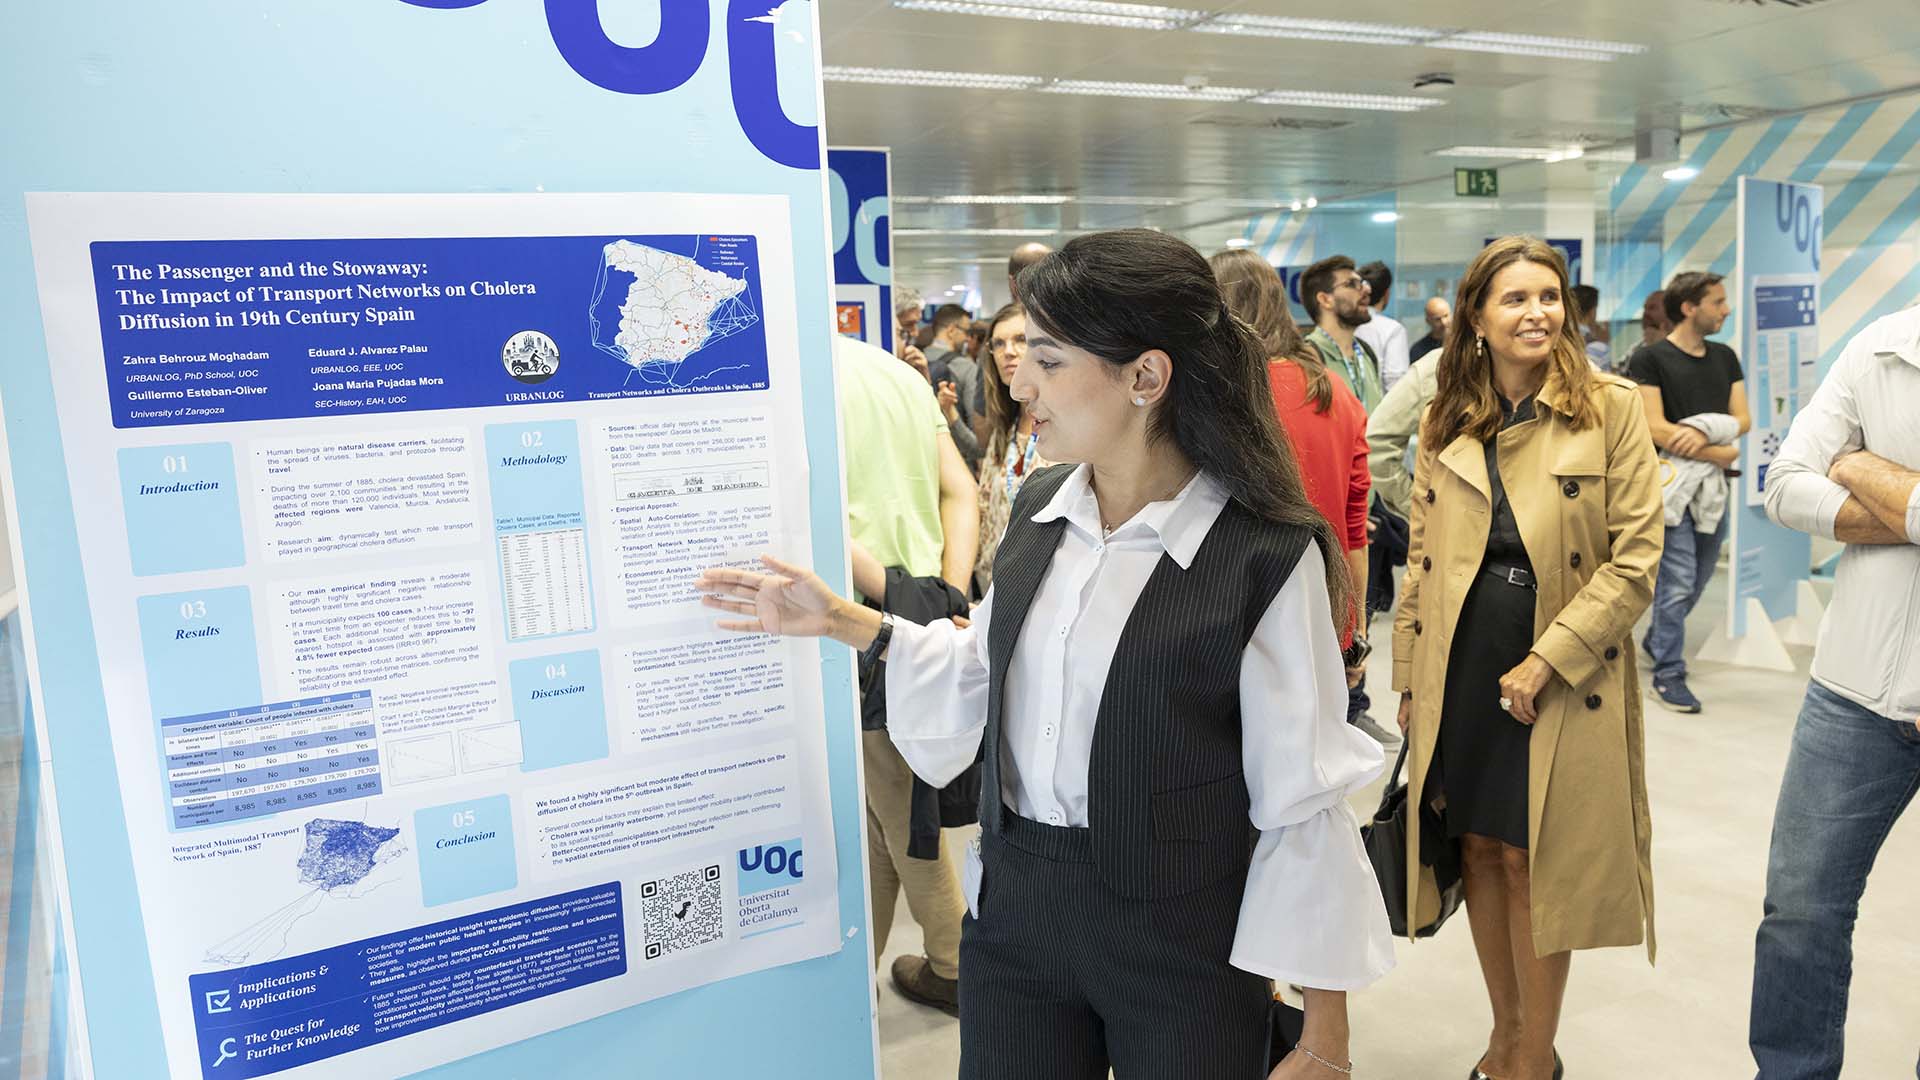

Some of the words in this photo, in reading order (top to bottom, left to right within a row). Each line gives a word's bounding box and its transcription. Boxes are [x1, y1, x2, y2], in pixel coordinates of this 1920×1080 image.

[112, 265, 152, 280] The
[158, 264, 254, 282] Passenger
[260, 262, 294, 277] and
[299, 262, 328, 276] the
[333, 261, 427, 278] Stowaway:
[116, 290, 155, 305] The
[160, 289, 230, 307] Impact
[236, 287, 255, 302] of
[259, 286, 353, 304] Transport
[357, 283, 440, 298] Networks
[445, 286, 466, 296] on
[471, 281, 536, 296] Cholera
[119, 313, 210, 330] Diffusion
[216, 312, 234, 327] in
[240, 311, 280, 326] 19th
[286, 310, 360, 326] Century
[366, 307, 415, 325] Spain
[123, 356, 156, 365] Zahra
[160, 354, 207, 363] Behrouz
[209, 352, 269, 362] Moghadam
[309, 348, 346, 357] Eduard
[400, 345, 427, 353] Palau
[126, 373, 182, 383] URBANLOG,
[311, 365, 361, 374] URBANLOG,
[128, 391, 183, 400] Guillermo
[187, 386, 267, 397] Esteban-Oliver
[313, 383, 344, 391] Joana
[347, 380, 374, 389] Maria
[377, 378, 416, 389] Pujadas
[506, 391, 564, 402] URBANLOG
[131, 410, 173, 418] University
[521, 431, 543, 448] 02
[163, 456, 188, 473] 01
[503, 454, 567, 466] Methodology
[141, 481, 218, 495] Introduction
[181, 600, 206, 620] 03
[176, 626, 219, 639] Results
[545, 664, 567, 679] 04
[532, 685, 584, 699] Discussion
[183, 724, 216, 733] Dependent
[550, 796, 570, 805] found
[600, 784, 635, 795] significant
[649, 776, 679, 786] moderate
[708, 764, 736, 774] transport
[738, 759, 766, 768] networks
[235, 802, 256, 812] 8,985
[266, 797, 287, 806] 8,985
[297, 791, 318, 801] 8,985
[327, 786, 347, 796] 8,985
[357, 781, 377, 790] 8,985
[538, 806, 568, 816] diffusion
[578, 800, 603, 808] cholera
[635, 787, 664, 797] outbreak
[452, 809, 475, 828] 05
[172, 842, 211, 853] Integrated
[214, 834, 259, 846] Multimodal
[262, 828, 299, 838] Transport
[436, 832, 495, 848] Conclusion
[174, 853, 205, 861] Network
[245, 843, 261, 851] 1887
[739, 889, 789, 906] Universitat
[739, 904, 770, 917] Oberta
[739, 918, 751, 927] de
[752, 908, 798, 923] Catalunya
[381, 941, 407, 951] findings
[425, 928, 458, 940] historical
[459, 922, 483, 934] insight
[499, 912, 529, 926] epidemic
[530, 905, 559, 915] diffusion,
[562, 898, 590, 911] providing
[591, 892, 615, 901] valuable
[239, 970, 316, 994] Implications
[320, 965, 328, 975] &
[240, 985, 316, 1009] Applications
[244, 1032, 267, 1045] The
[270, 1024, 304, 1040] Quest
[308, 1019, 324, 1032] for
[246, 1041, 293, 1060] Further
[296, 1024, 360, 1048] Knowledge
